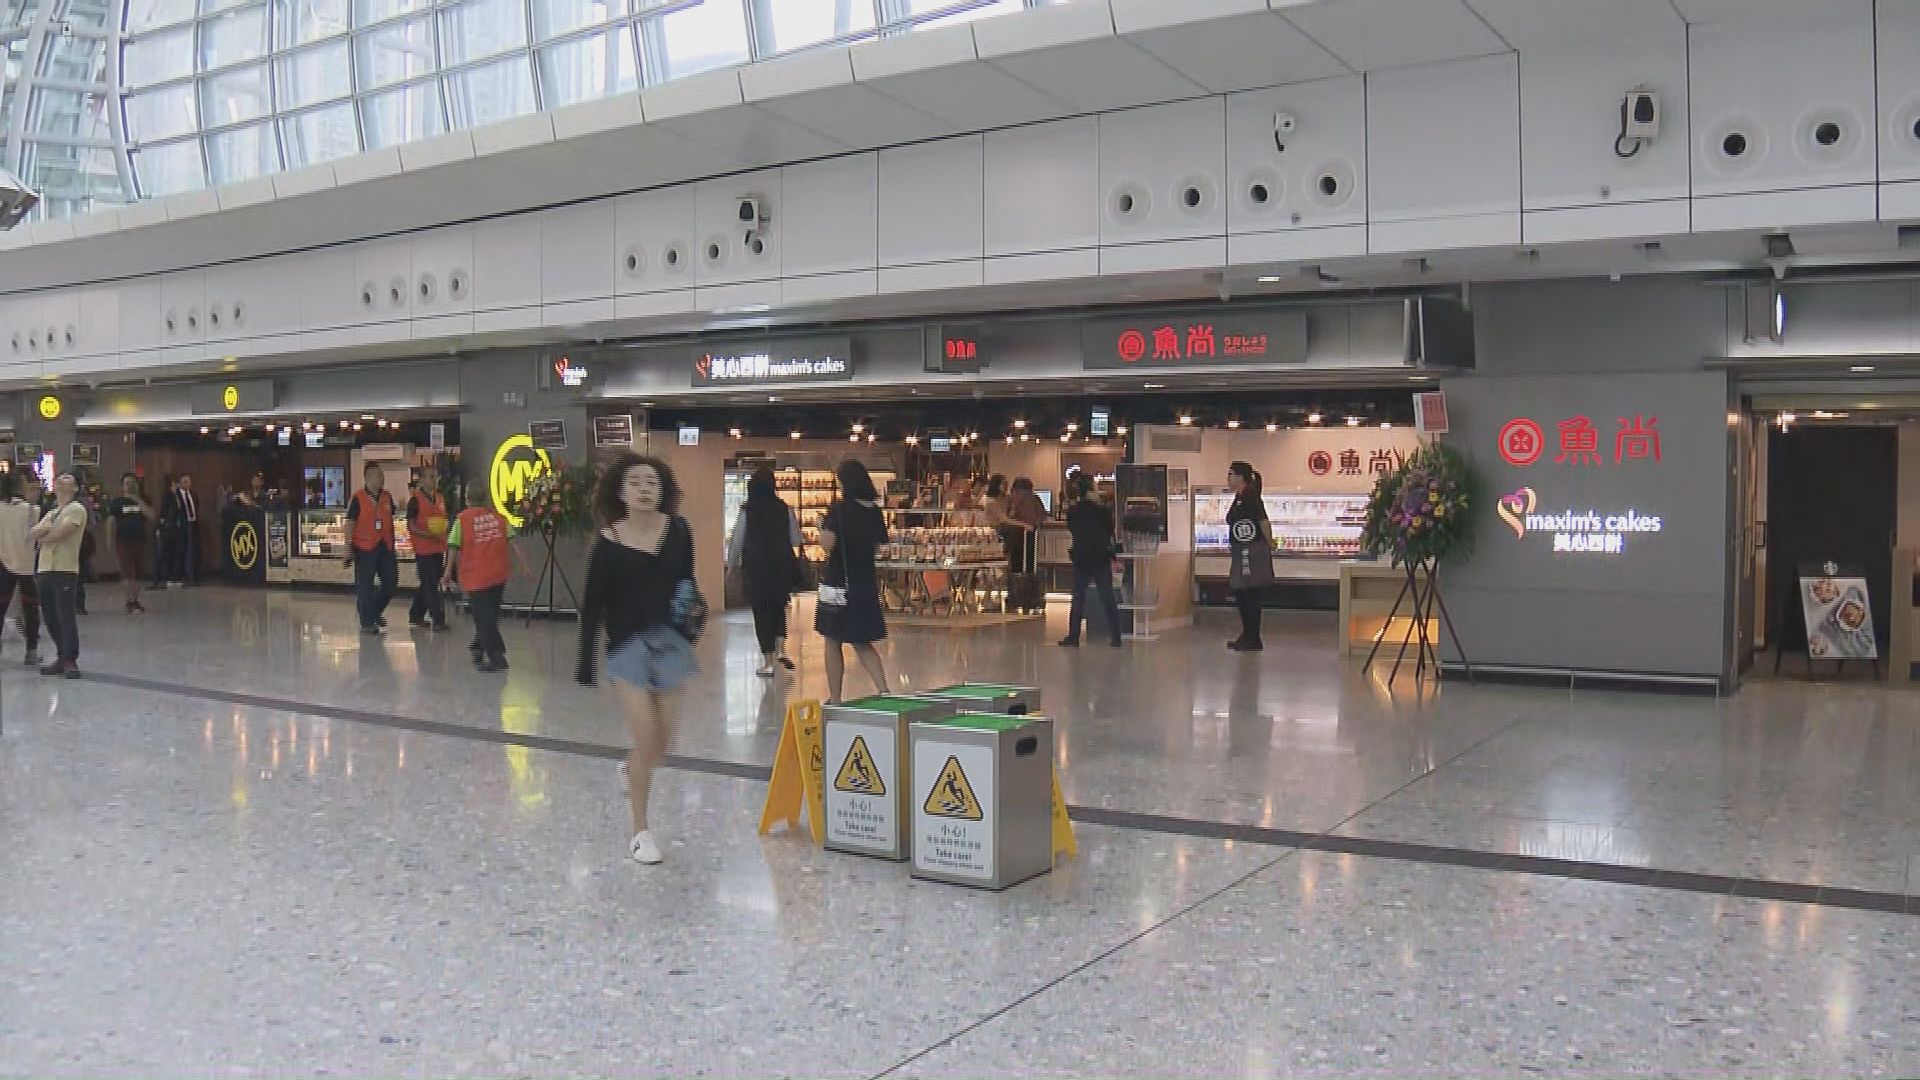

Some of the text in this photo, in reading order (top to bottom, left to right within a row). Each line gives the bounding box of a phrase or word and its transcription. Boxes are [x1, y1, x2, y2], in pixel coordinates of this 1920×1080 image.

[1152, 323, 1216, 360] 魚尚
[769, 356, 846, 376] maxim's cakes
[1554, 413, 1662, 465] 魚尚
[1337, 448, 1393, 475] 魚尚
[1526, 509, 1662, 532] maxim's cakes
